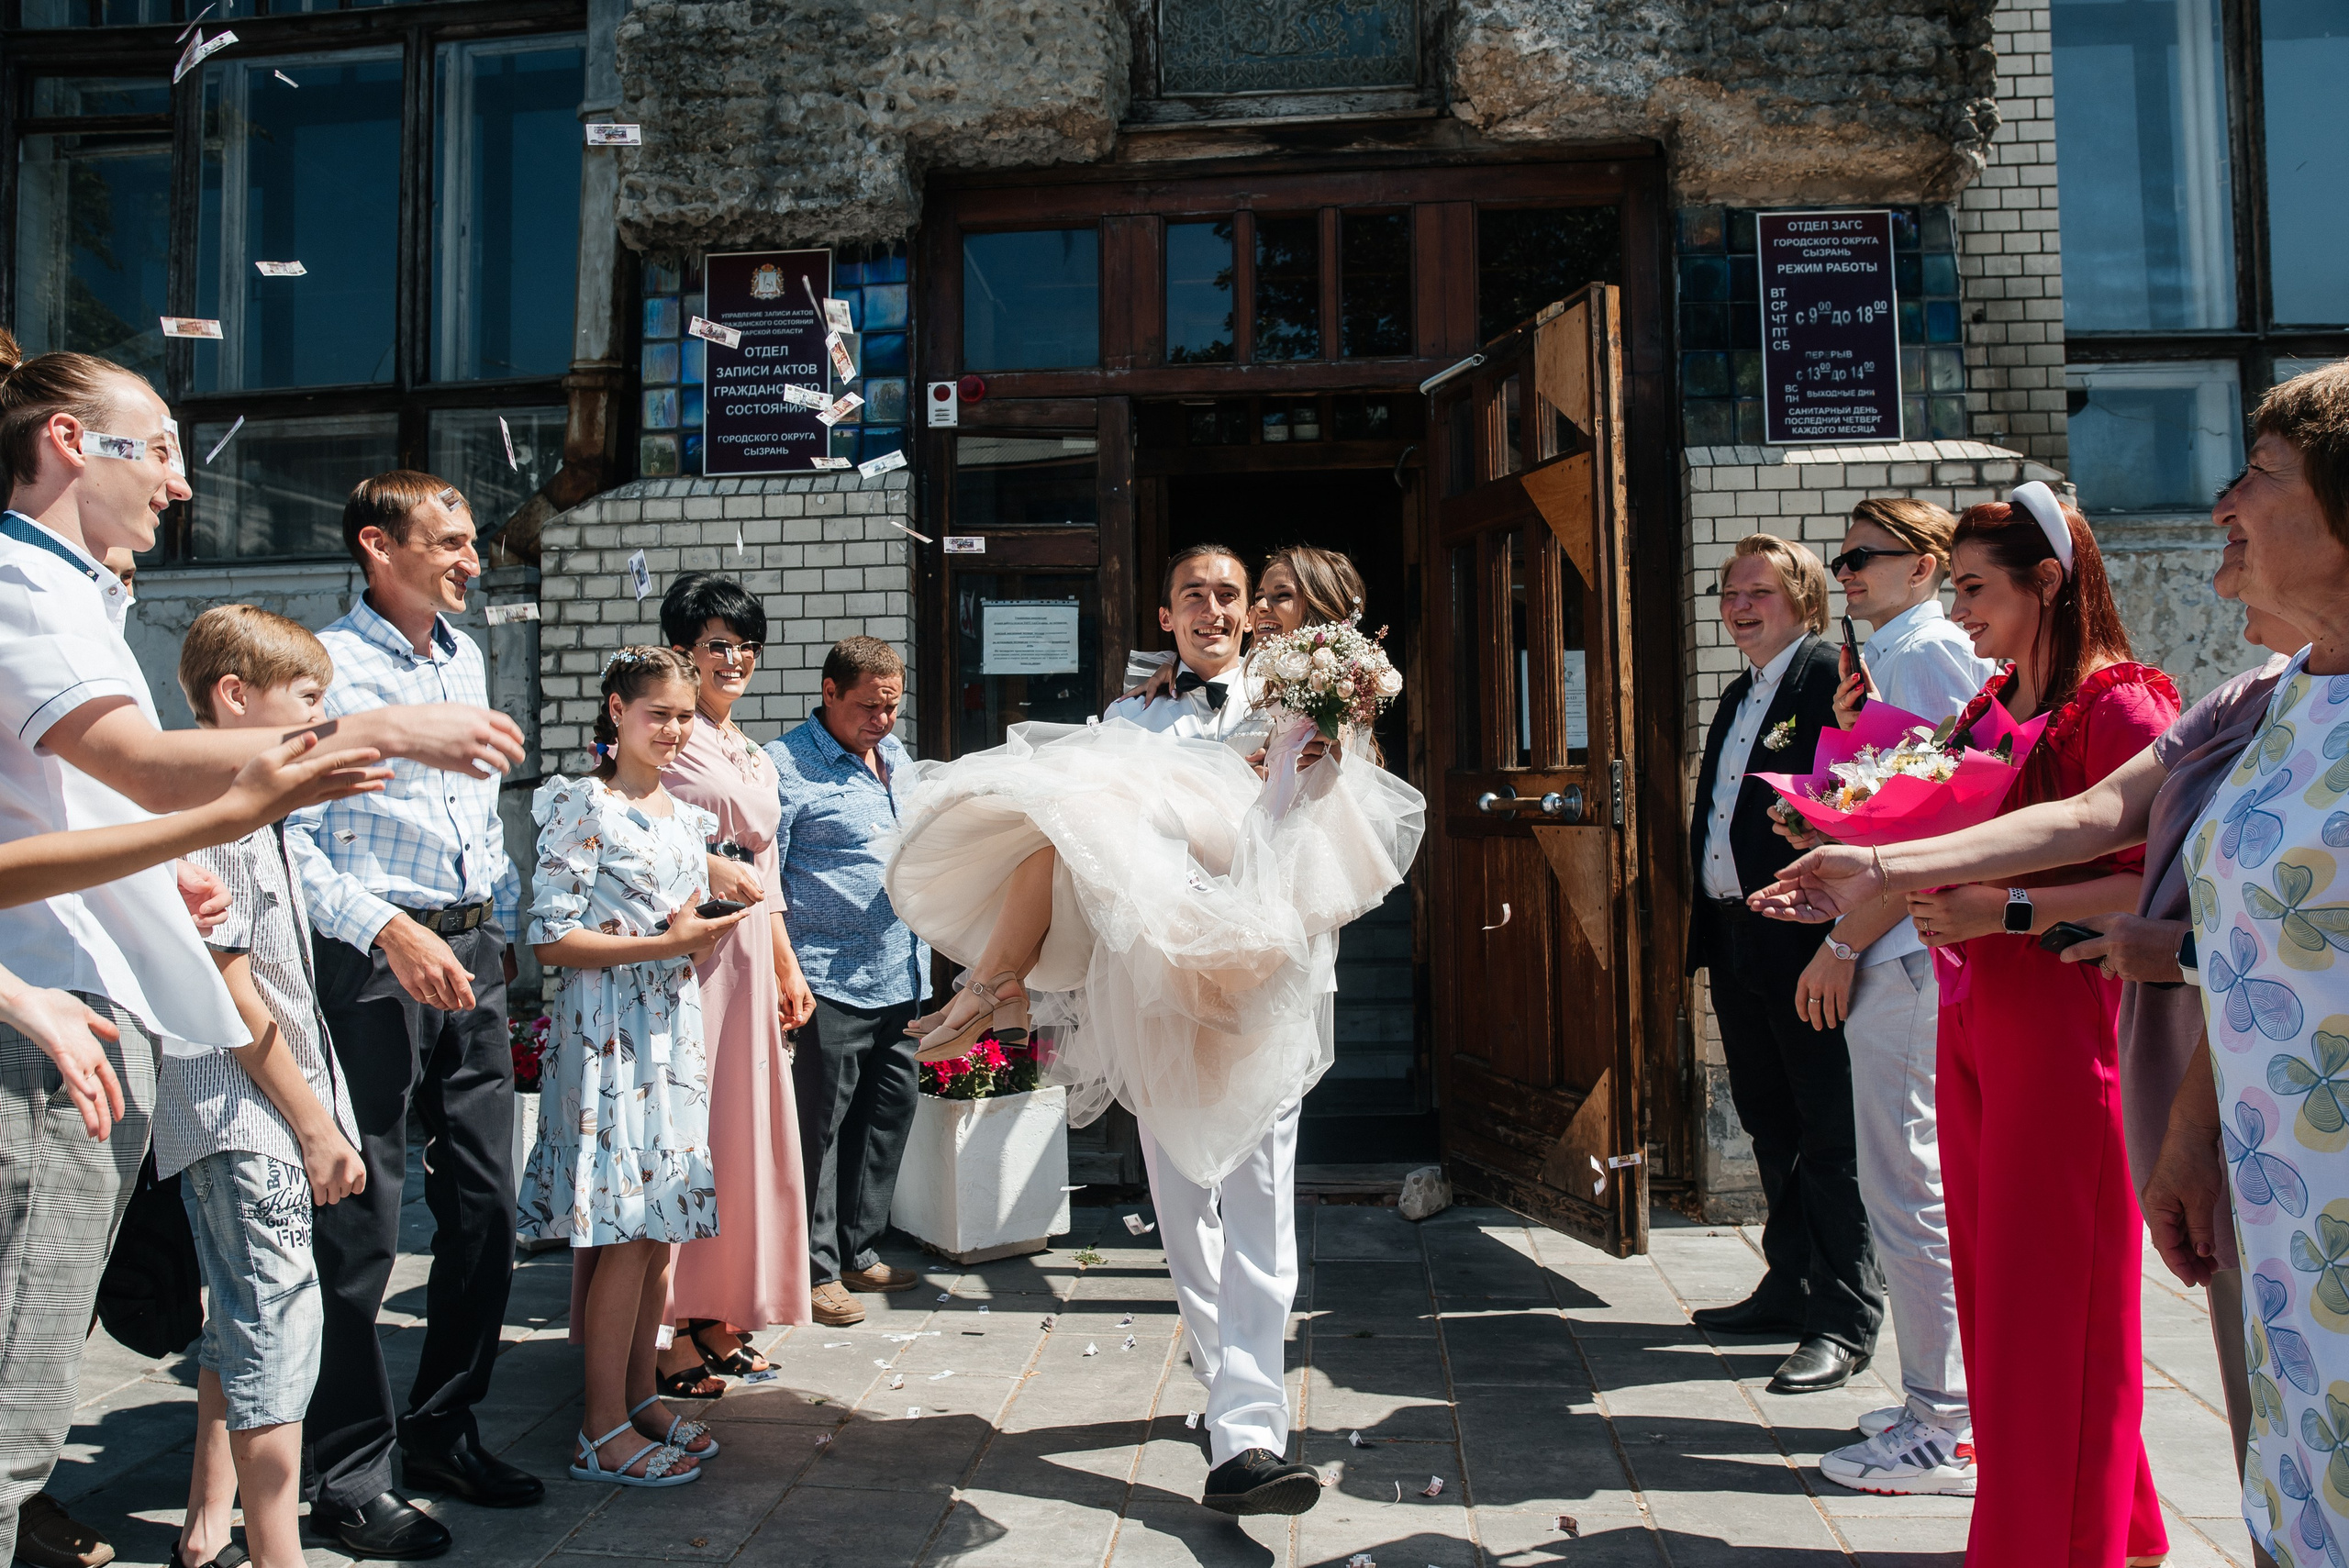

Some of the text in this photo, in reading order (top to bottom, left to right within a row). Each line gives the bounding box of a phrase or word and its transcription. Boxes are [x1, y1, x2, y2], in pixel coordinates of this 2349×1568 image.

[1787, 220, 1863, 232] ОТДЕЛ ЗАГС
[1774, 237, 1879, 247] ГОРОДСКОГО ОКРУГА
[1802, 248, 1851, 257] СЫЗРАНЬ
[1777, 262, 1878, 274] РЕЖИМ РАБОТЫ
[1770, 287, 1787, 298] ВТ
[1771, 301, 1787, 311] СР
[1772, 314, 1787, 324] ЧТ
[1831, 310, 1851, 327] до
[1772, 328, 1788, 338] ПТ
[1773, 340, 1790, 350] СБ
[744, 346, 789, 358] ОТДЕЛ
[716, 364, 818, 378] ЗАПИСИ АКТОВ
[1785, 384, 1798, 393] ВС
[1785, 395, 1798, 403] ПН
[1807, 390, 1855, 398] ВЫХОДНЫЕ
[726, 403, 807, 416] СОСТОЯНИЯ
[1788, 406, 1877, 416] САНИТАРНЫЙ ДЕНЬ
[1785, 416, 1841, 425] ПОСЛЕДНИЙ
[1792, 425, 1876, 435] КАЖДОГО МЕСЯЦА
[718, 432, 816, 443] ГОРОДСКОГО ОКРУГА
[743, 447, 789, 456] СЫЗРАНЬ
